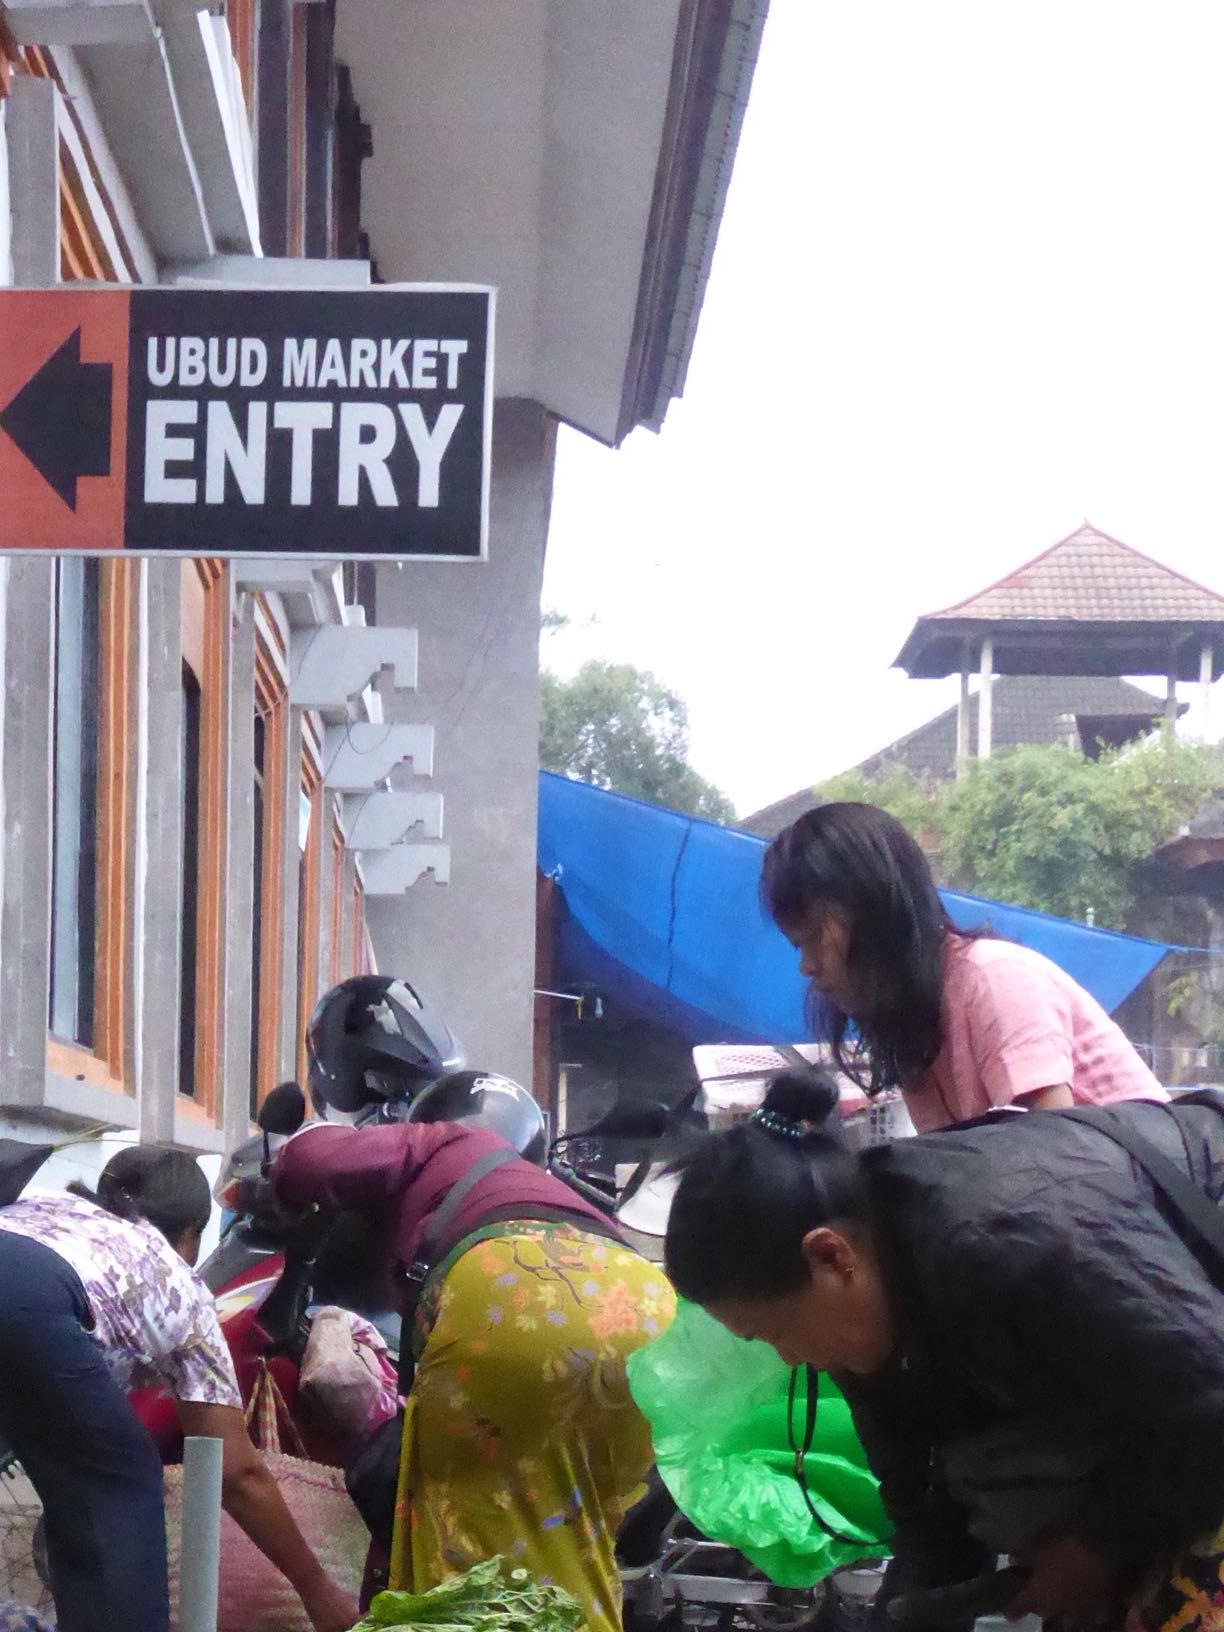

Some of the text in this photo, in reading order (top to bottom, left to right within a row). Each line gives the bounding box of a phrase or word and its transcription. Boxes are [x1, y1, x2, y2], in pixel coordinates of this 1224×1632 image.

[147, 336, 468, 390] UBUD MARKET
[144, 400, 466, 508] ENTRY
